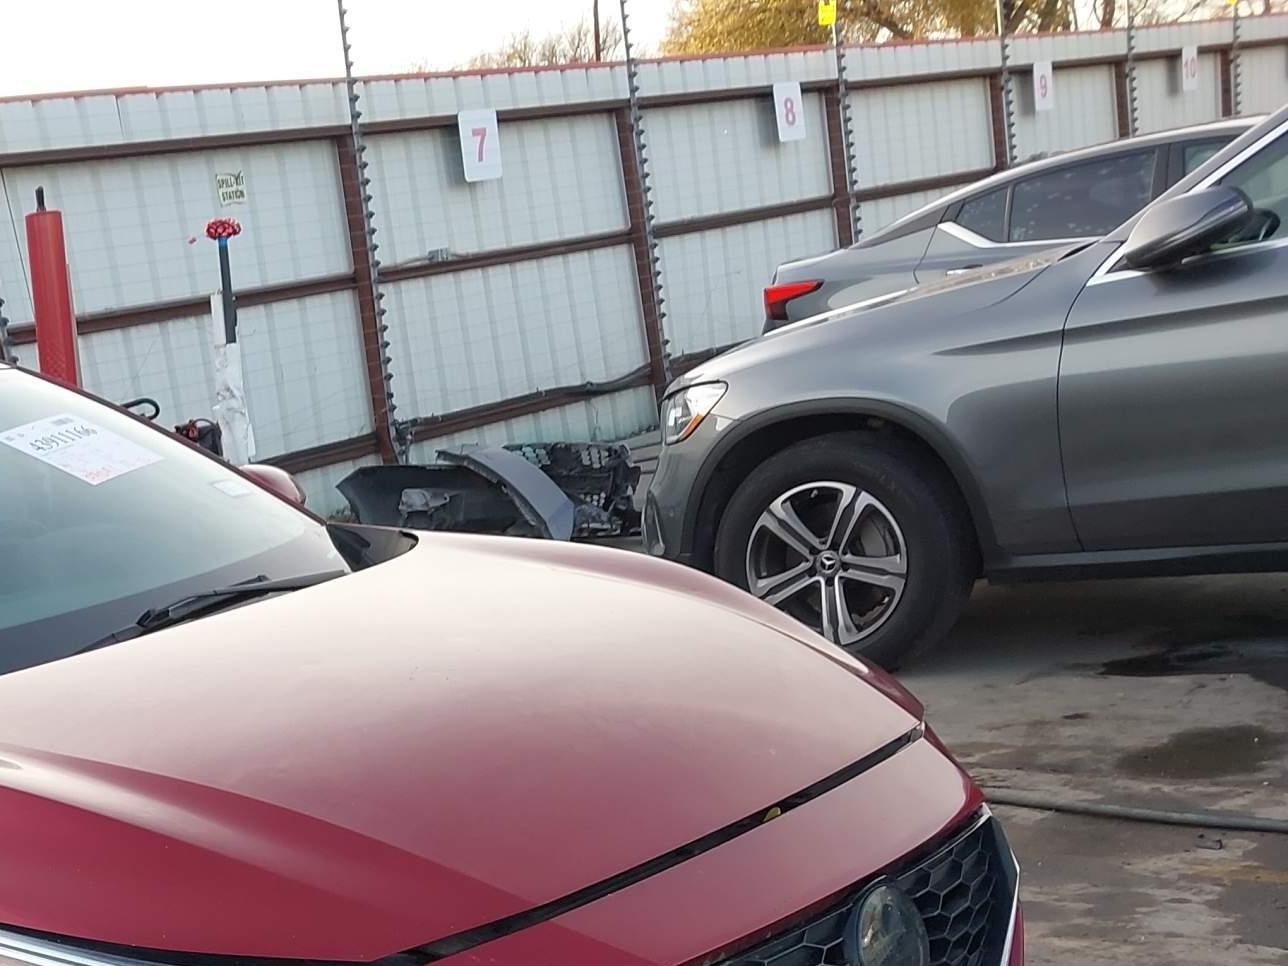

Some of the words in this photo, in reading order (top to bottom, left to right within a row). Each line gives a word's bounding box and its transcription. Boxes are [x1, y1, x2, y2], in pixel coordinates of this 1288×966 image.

[1039, 75, 1048, 97] 9
[784, 98, 797, 126] 8
[472, 128, 487, 163] 7
